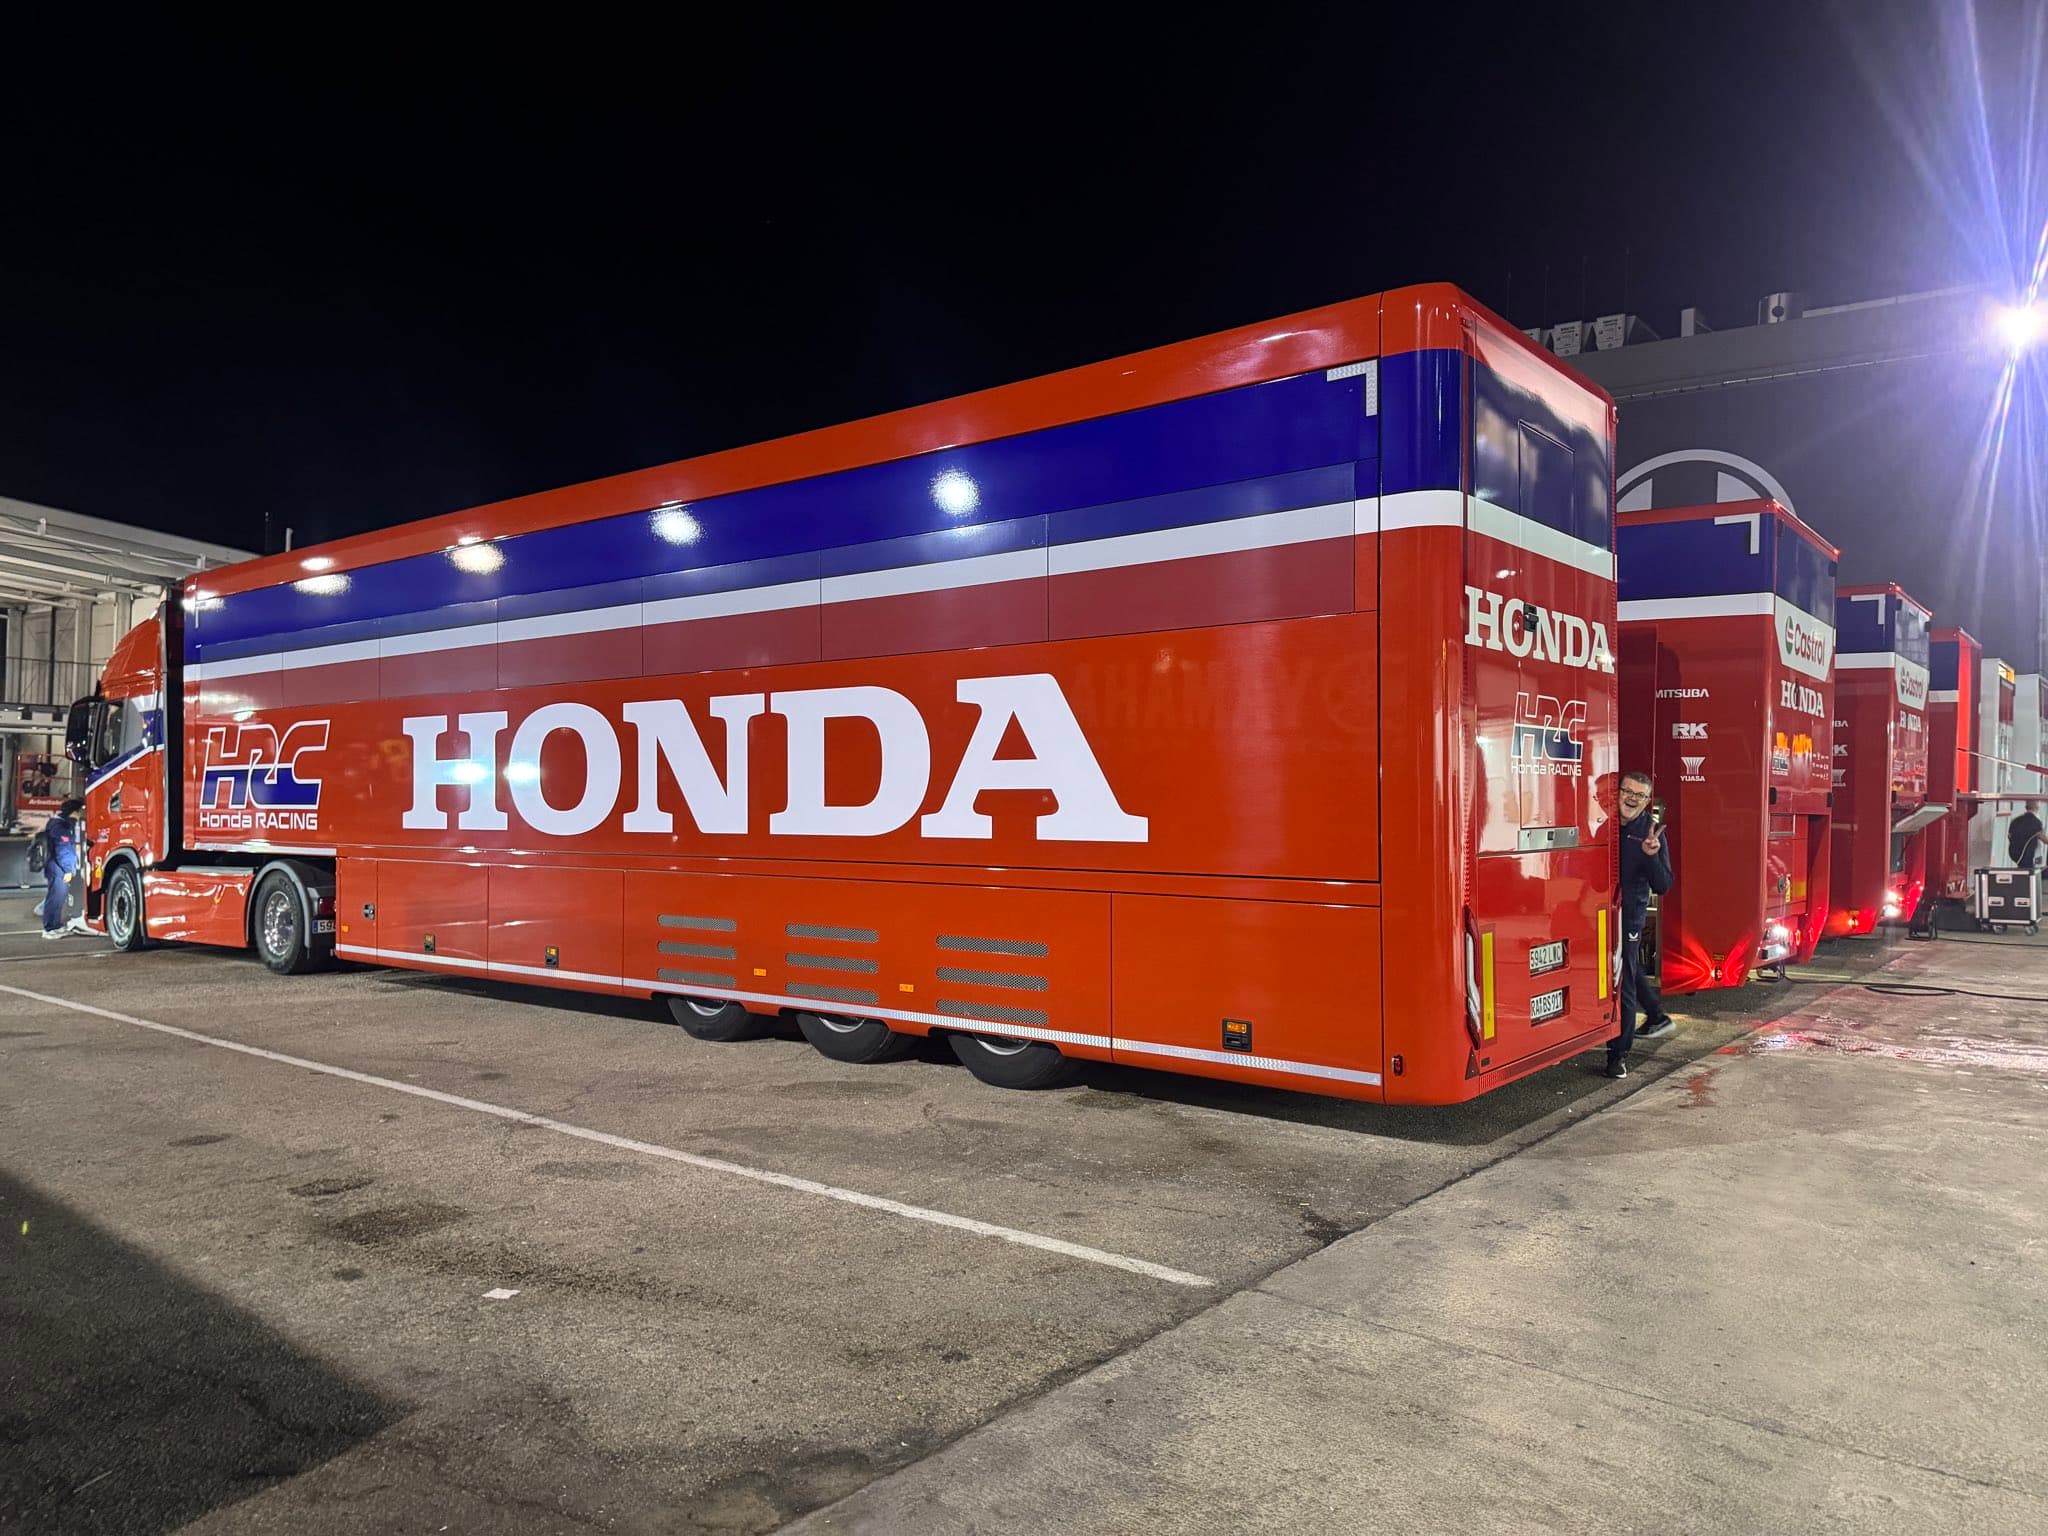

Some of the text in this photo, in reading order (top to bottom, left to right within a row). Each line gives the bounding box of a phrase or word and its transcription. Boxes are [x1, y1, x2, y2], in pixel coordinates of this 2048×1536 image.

[1465, 585, 1614, 673] HONDA
[1794, 623, 1826, 666] Castrol
[1511, 691, 1587, 763] HRC
[1672, 723, 1708, 737] RK
[1900, 710, 1922, 732] HNDA
[200, 719, 331, 810] HRC
[402, 672, 1149, 843] HONDA
[1511, 761, 1582, 777] Honda RACING
[200, 811, 318, 831] Honda RACING
